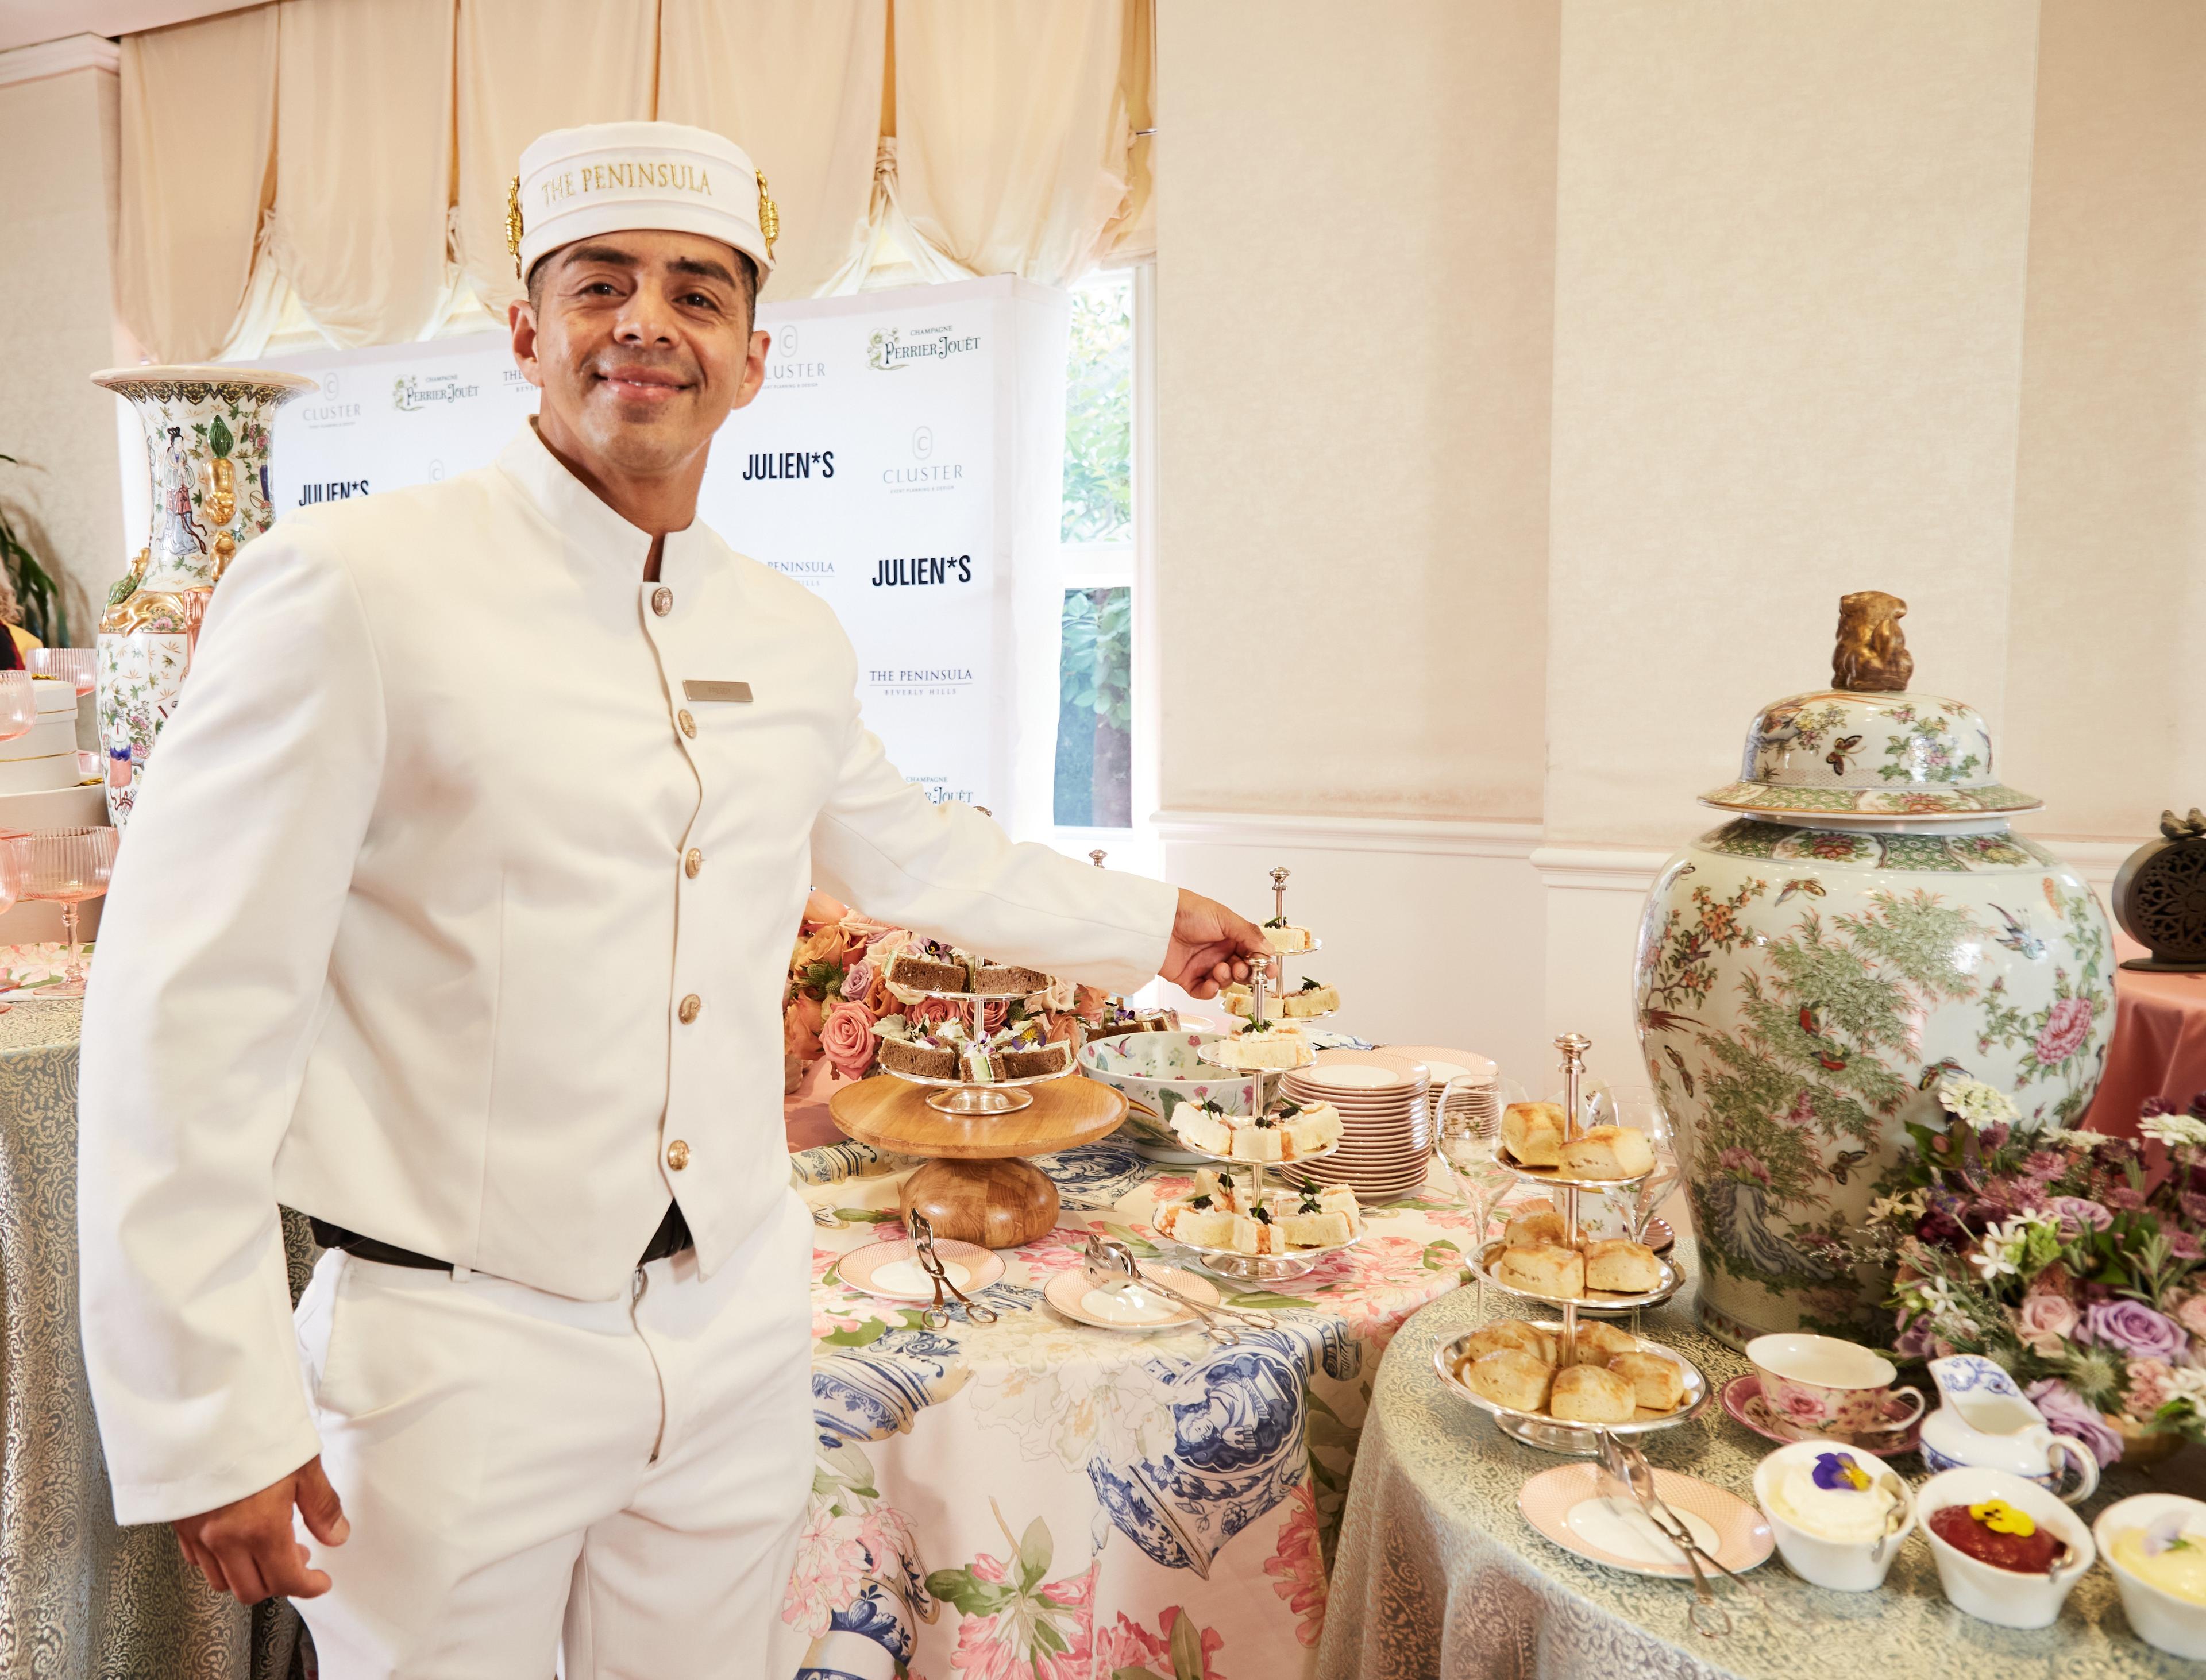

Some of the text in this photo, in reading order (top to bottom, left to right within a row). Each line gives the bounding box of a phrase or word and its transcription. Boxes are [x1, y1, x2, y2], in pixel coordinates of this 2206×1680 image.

[542, 163, 712, 207] THE PENINSULA
[910, 325, 953, 336] CHAMPAGNE
[765, 363, 826, 380] LUSTER
[303, 404, 361, 420] CLUSTER
[883, 464, 962, 483] CLUSTER
[869, 669, 973, 682] THE PENINSULA
